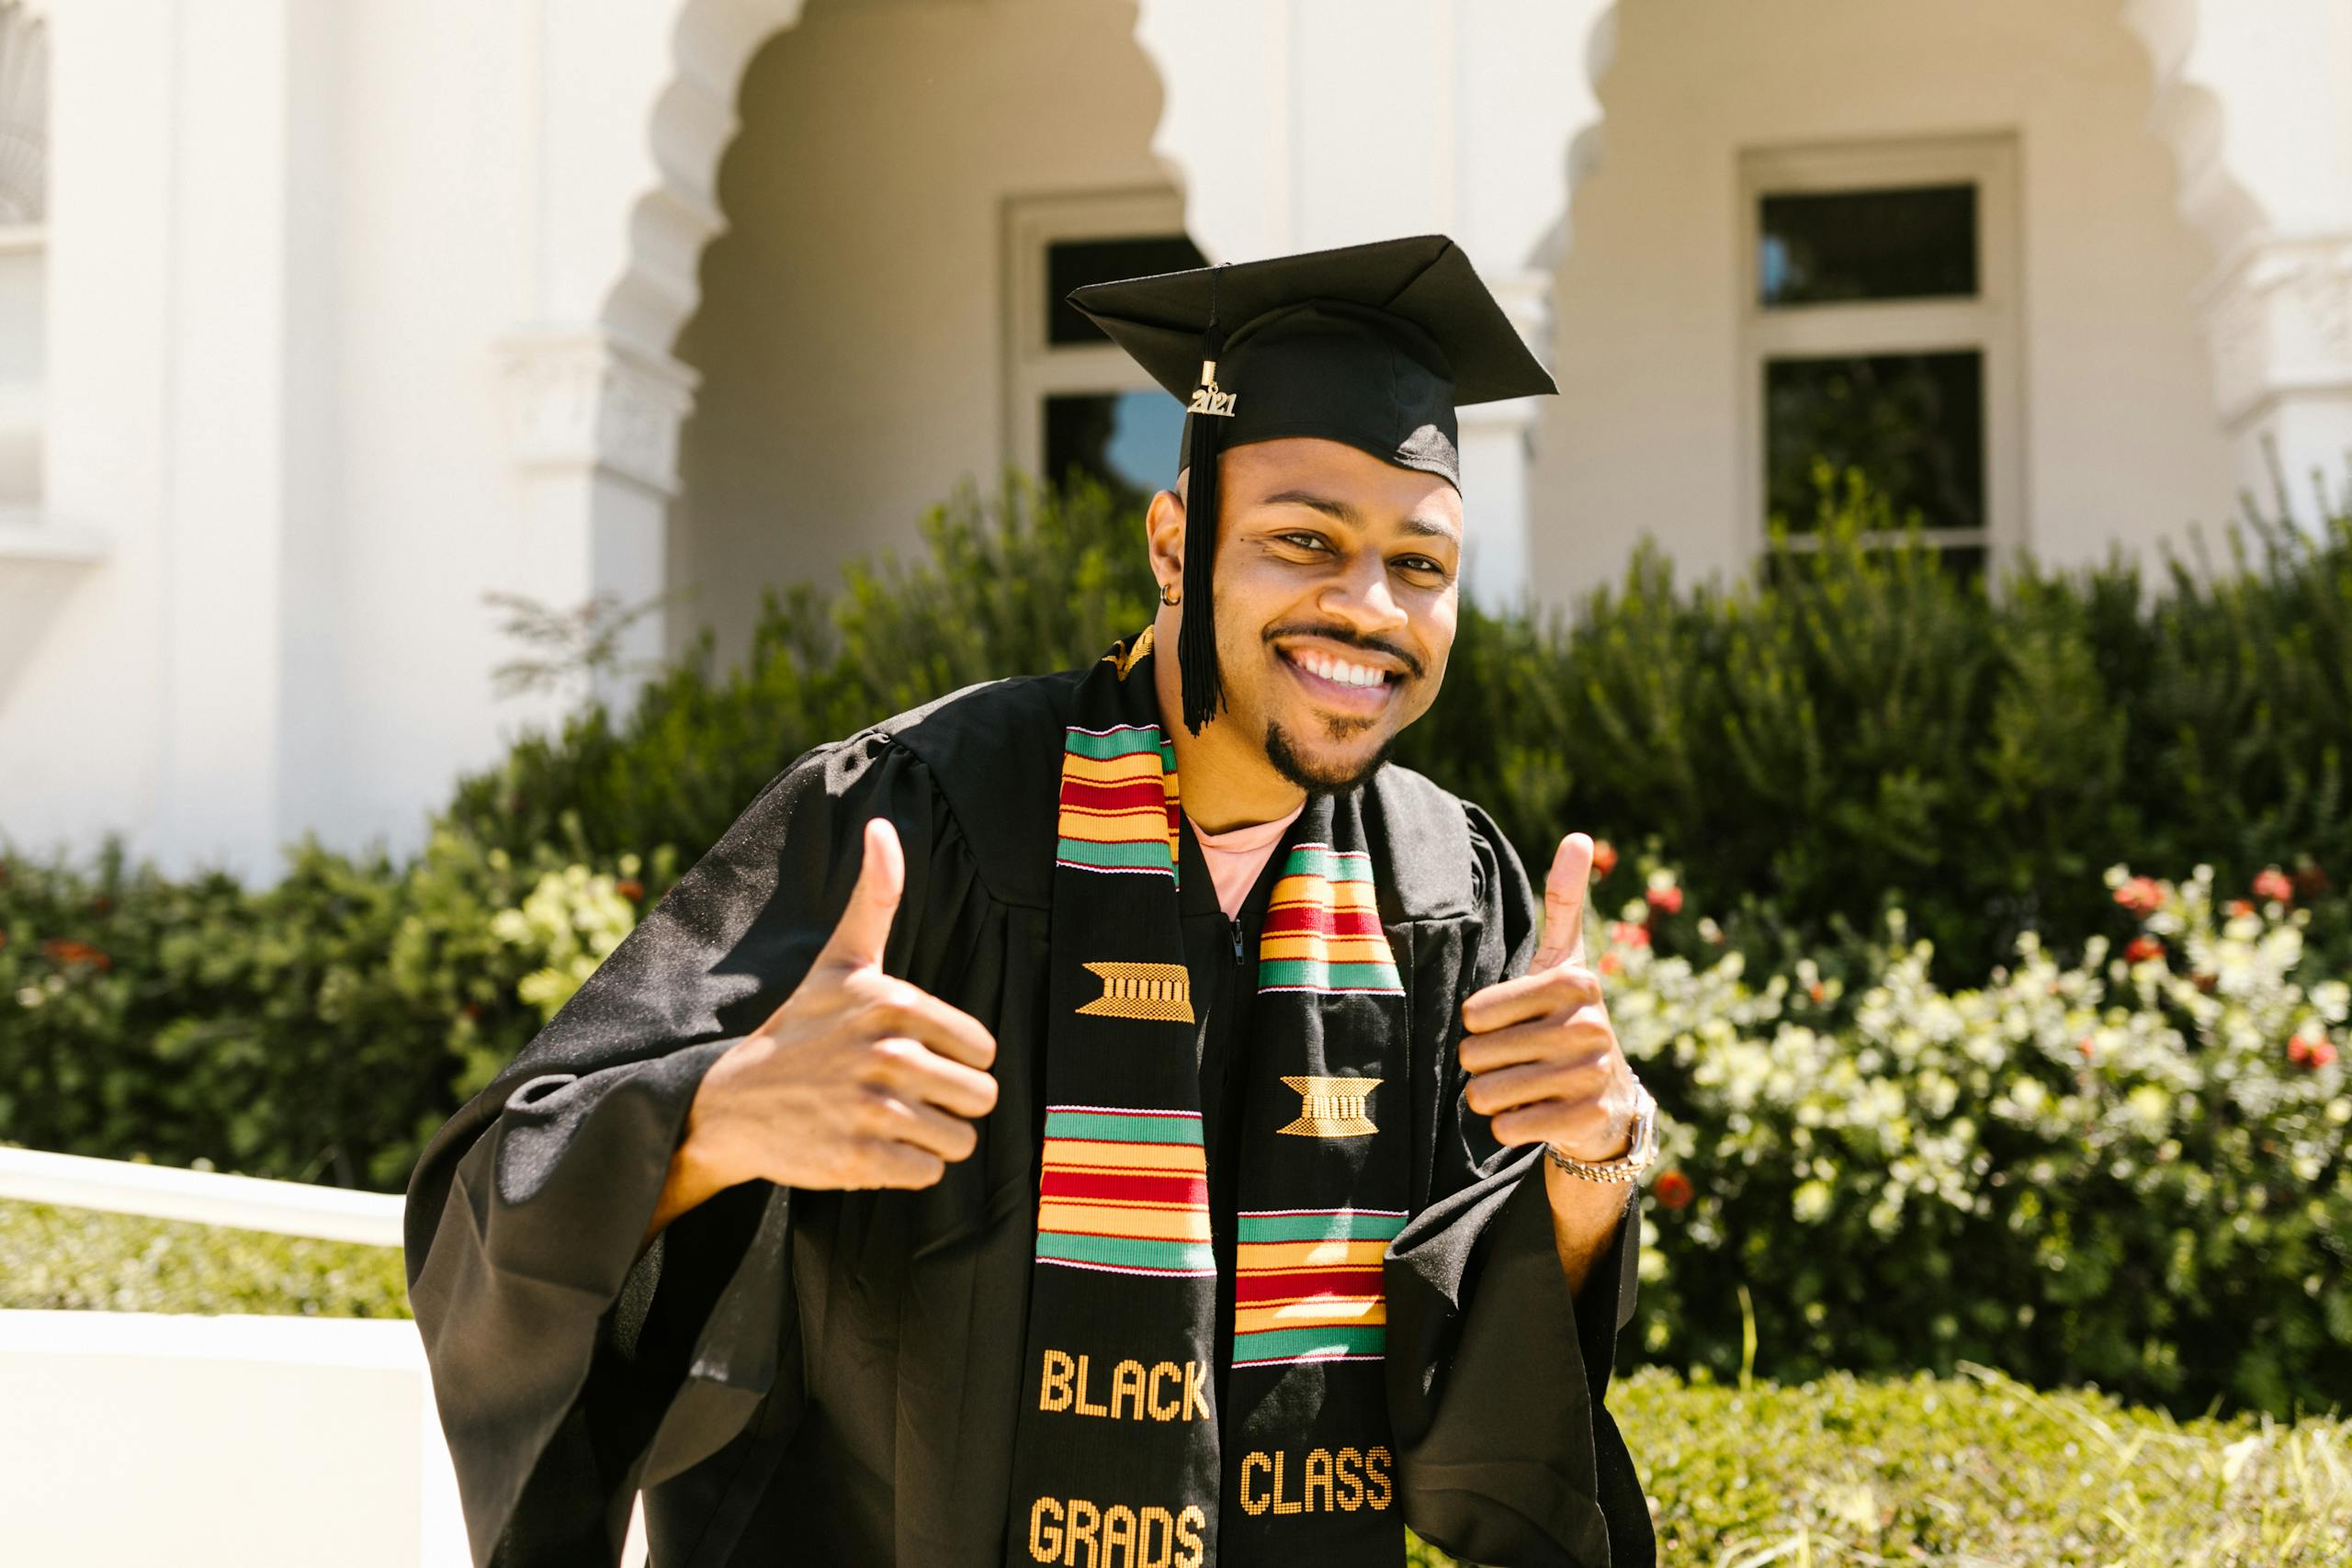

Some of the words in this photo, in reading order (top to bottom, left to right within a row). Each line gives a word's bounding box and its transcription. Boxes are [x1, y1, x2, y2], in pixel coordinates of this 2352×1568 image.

[1039, 1349, 1211, 1422] BLACK
[1239, 1446, 1393, 1516] CLASS
[1029, 1496, 1205, 1568] GRADS
